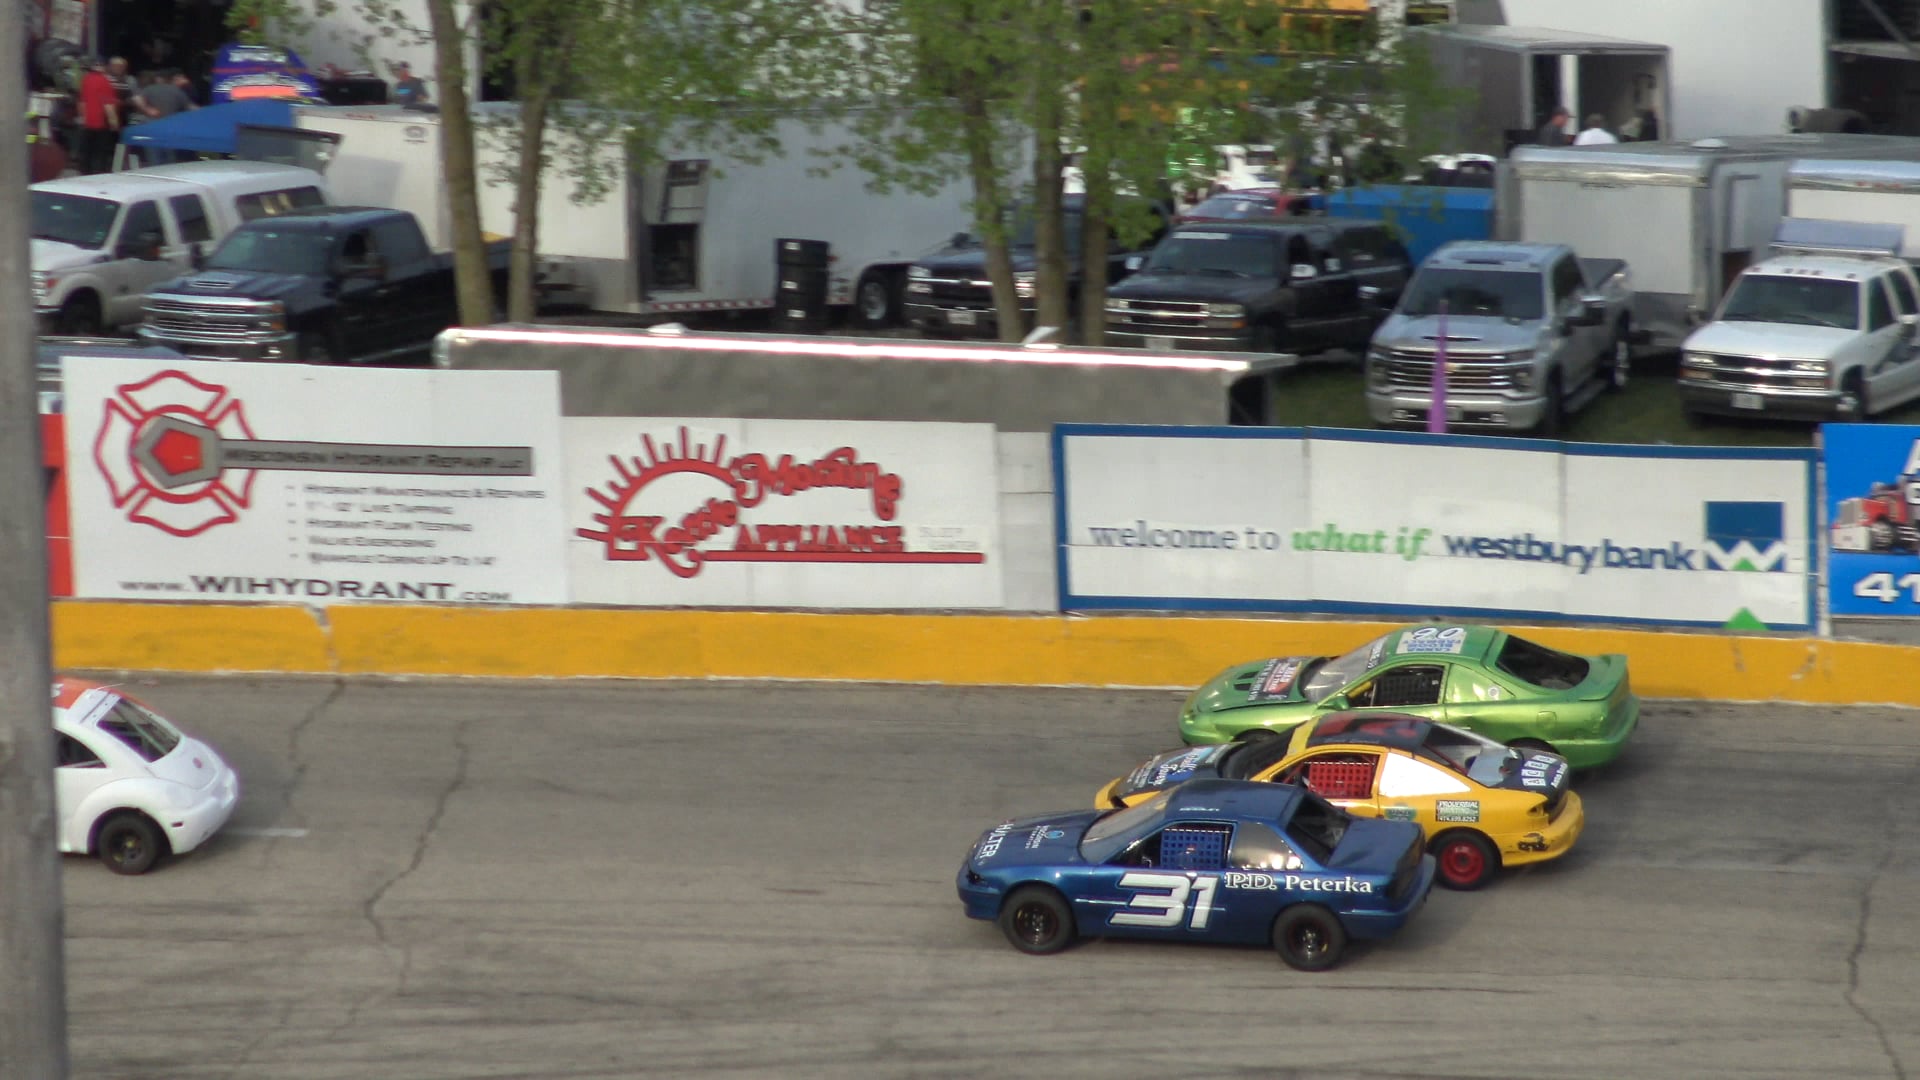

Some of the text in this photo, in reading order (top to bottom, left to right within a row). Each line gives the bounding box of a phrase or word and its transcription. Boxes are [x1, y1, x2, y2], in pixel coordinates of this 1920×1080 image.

[426, 454, 495, 469] REPAIR
[735, 524, 905, 552] APPLIANCE
[1088, 520, 1432, 562] welcome to what if
[1602, 538, 1697, 571] bank
[1284, 875, 1373, 893] Peterka
[1108, 871, 1219, 930] 31
